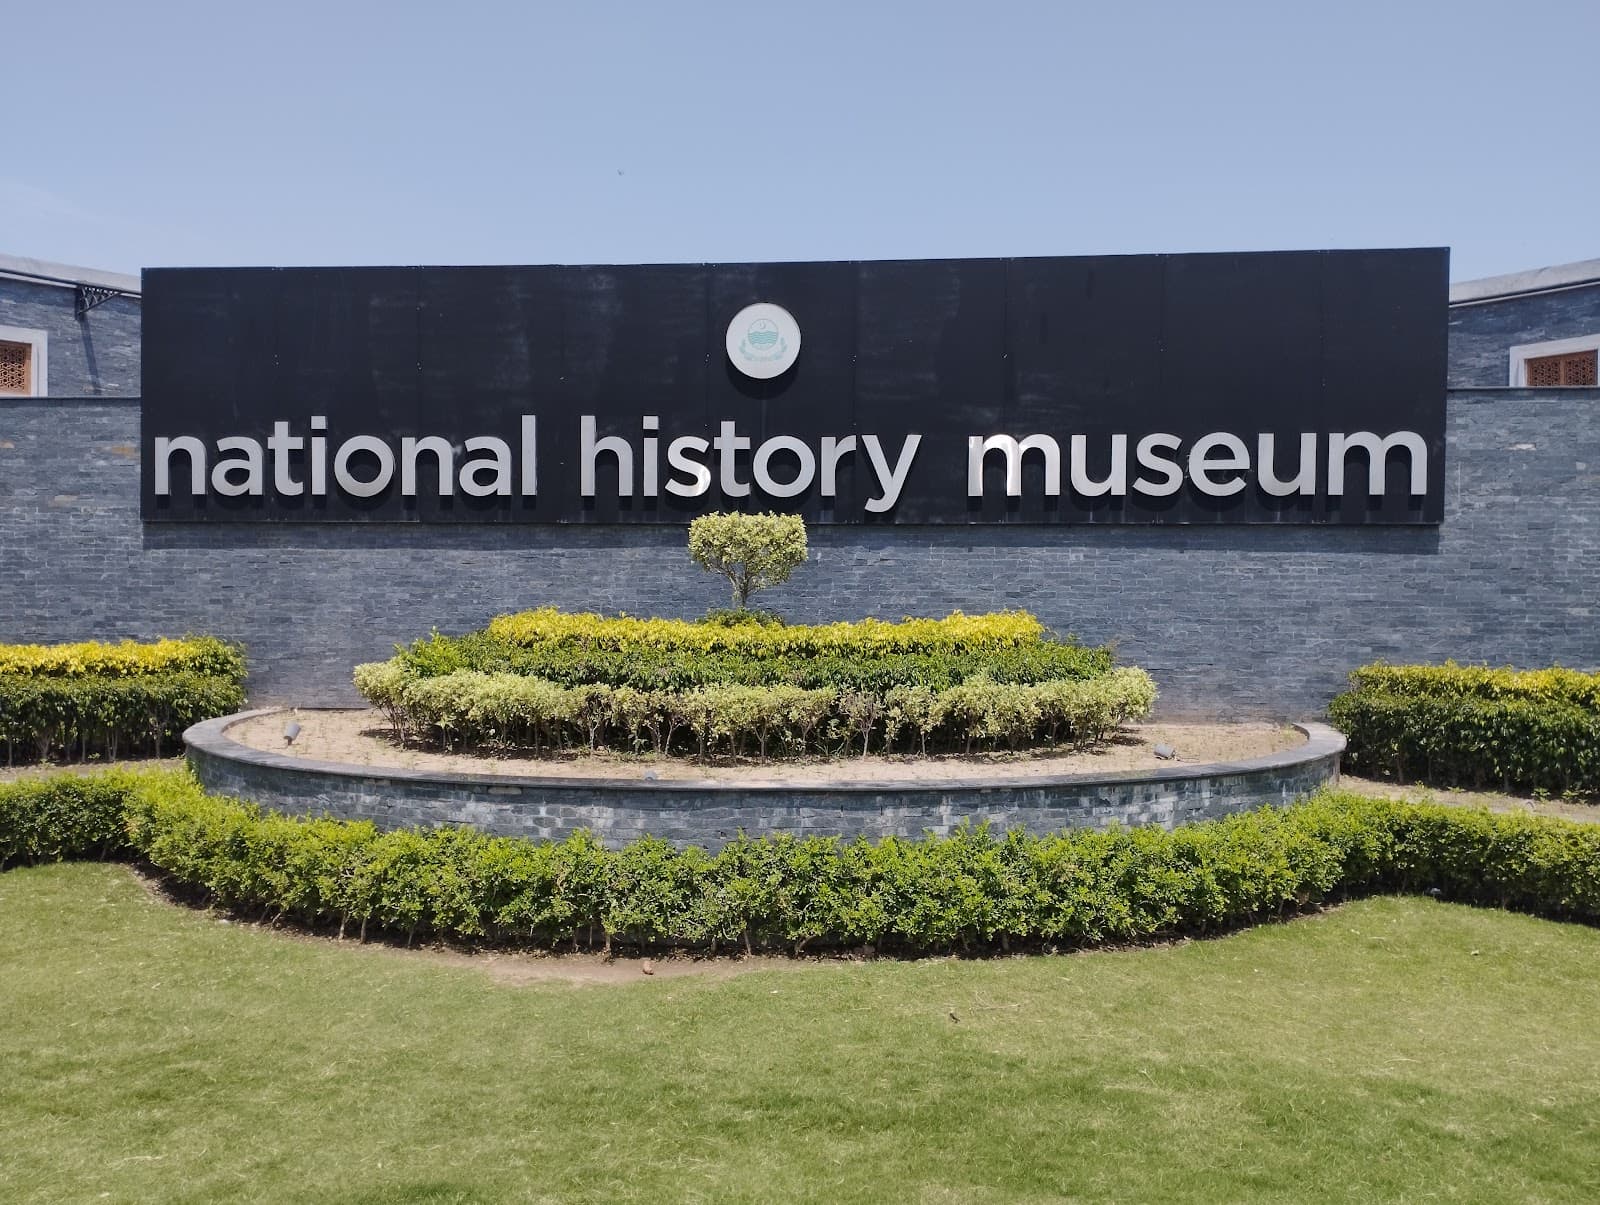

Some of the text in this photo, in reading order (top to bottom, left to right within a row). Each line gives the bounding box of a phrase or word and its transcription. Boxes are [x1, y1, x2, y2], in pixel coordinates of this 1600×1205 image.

[153, 414, 1428, 513] national history museum
